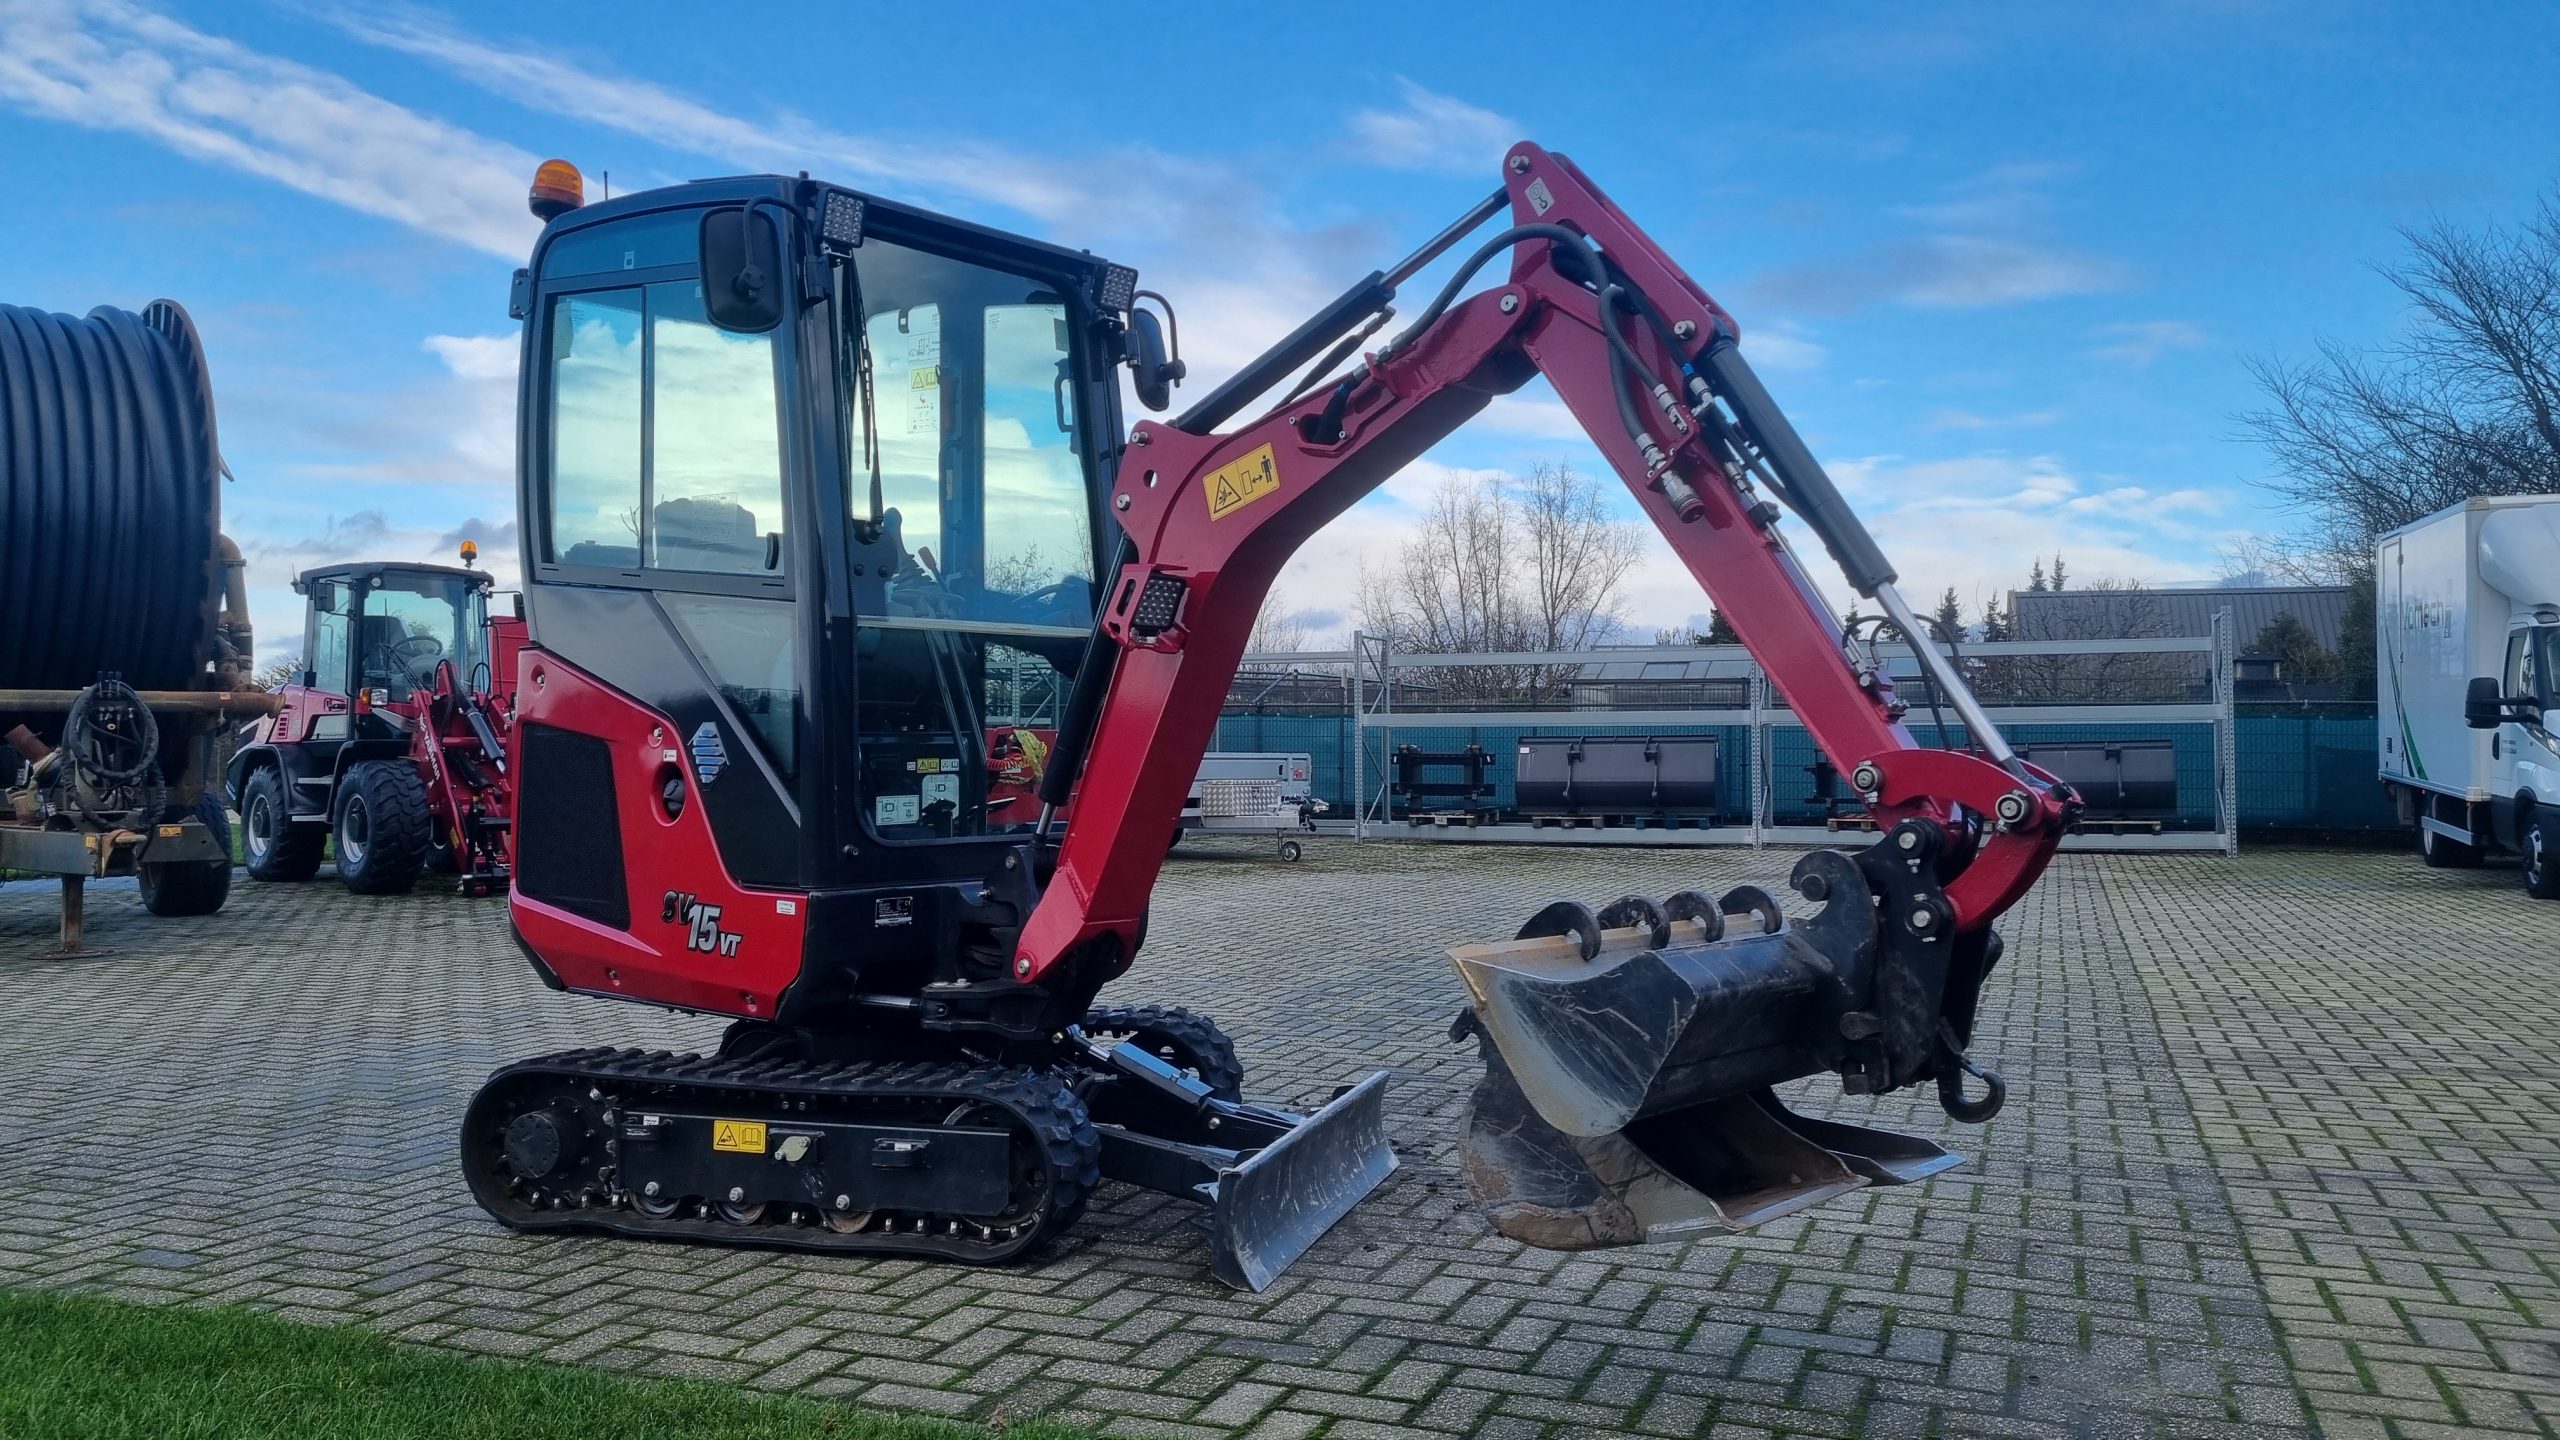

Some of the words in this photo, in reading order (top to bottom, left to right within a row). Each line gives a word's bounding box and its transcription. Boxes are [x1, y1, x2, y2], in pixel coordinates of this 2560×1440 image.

[662, 890, 695, 923] SV
[687, 903, 722, 952] 15
[720, 932, 742, 957] VT
